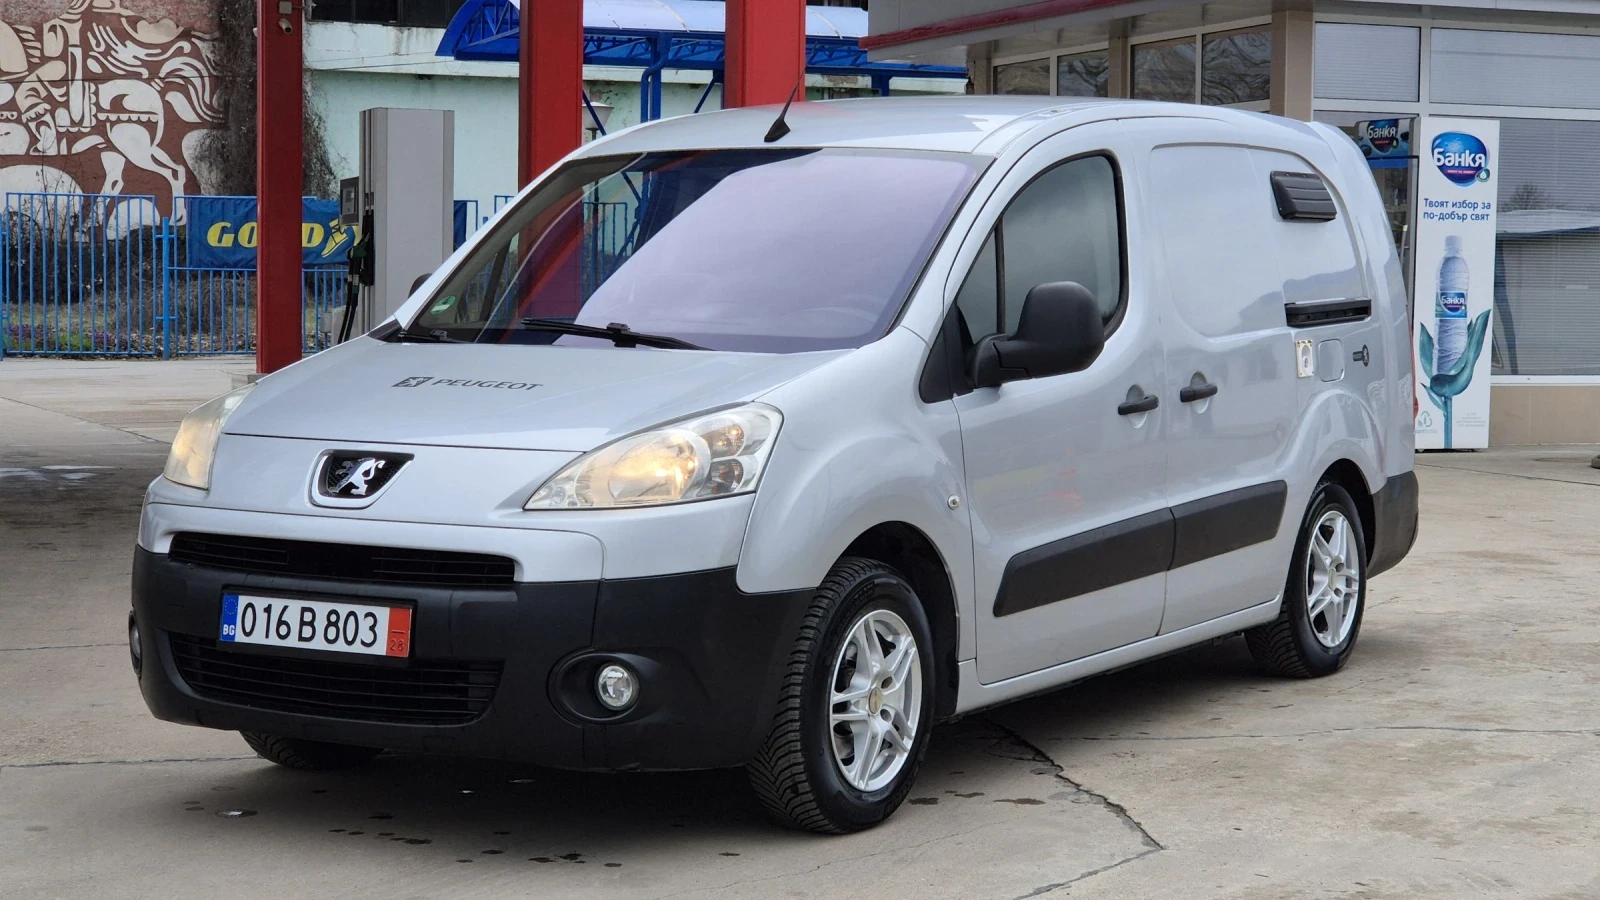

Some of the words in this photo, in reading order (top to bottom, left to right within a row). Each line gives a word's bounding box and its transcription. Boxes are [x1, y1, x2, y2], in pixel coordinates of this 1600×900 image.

[1423, 198, 1449, 208] Твоят
[1451, 200, 1479, 211] избор
[1481, 202, 1491, 210] за
[1423, 211, 1468, 223] по-добър
[1470, 213, 1490, 221] свят
[431, 378, 544, 391] PEUGEOT
[222, 624, 236, 636] BG
[389, 639, 404, 651] 28
